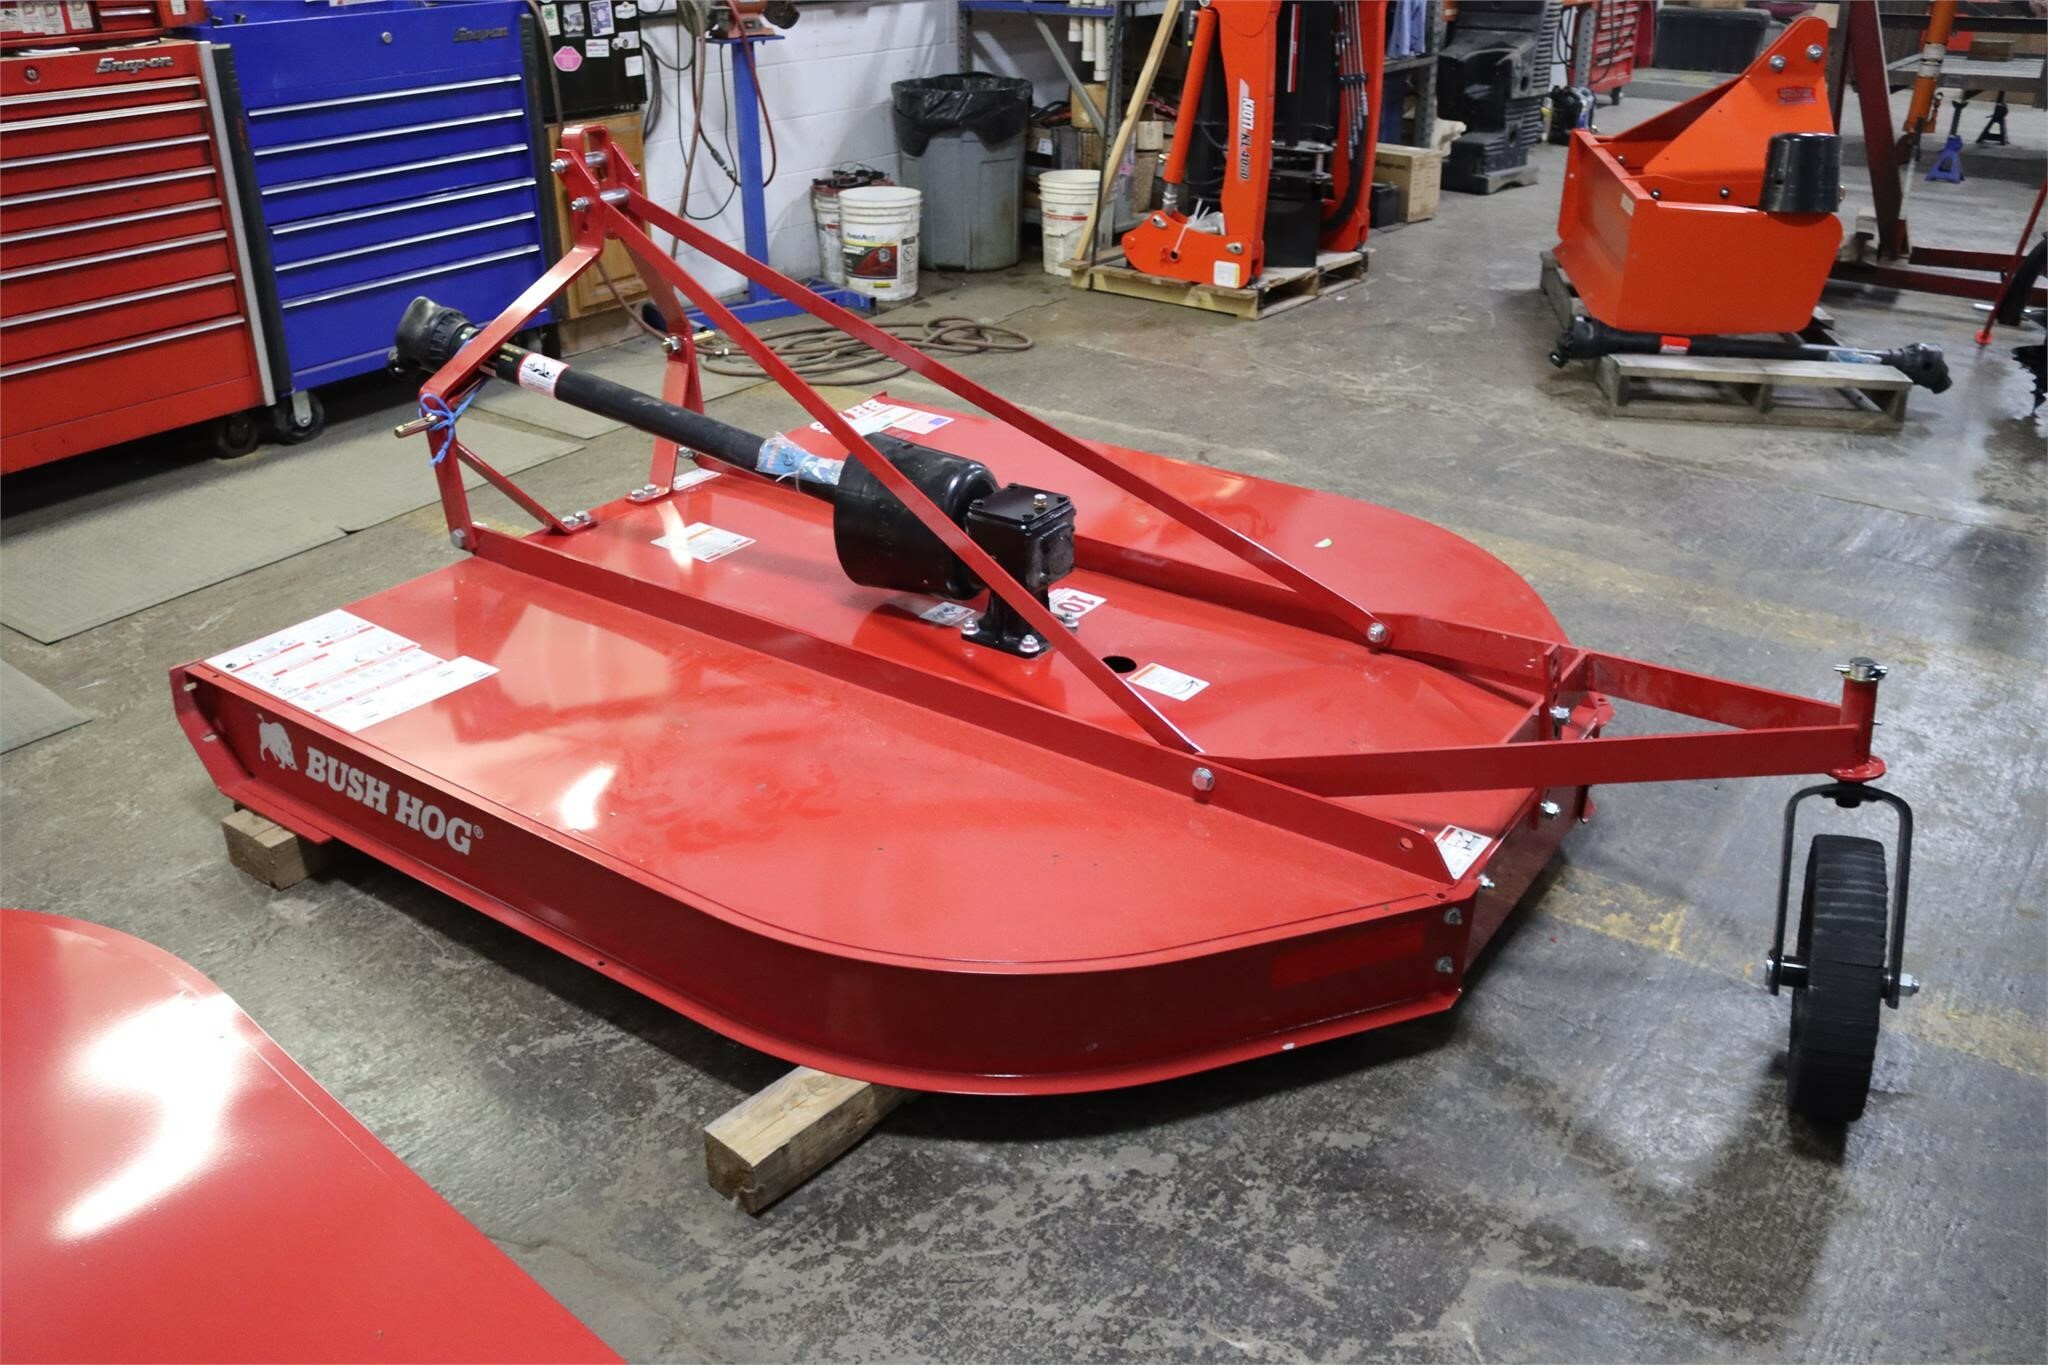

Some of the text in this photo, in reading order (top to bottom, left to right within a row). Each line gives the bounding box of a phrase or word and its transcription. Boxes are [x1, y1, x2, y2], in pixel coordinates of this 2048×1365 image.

[96, 57, 174, 74] Snap-on
[1242, 96, 1256, 131] KIOTI
[305, 746, 391, 815] BUSH
